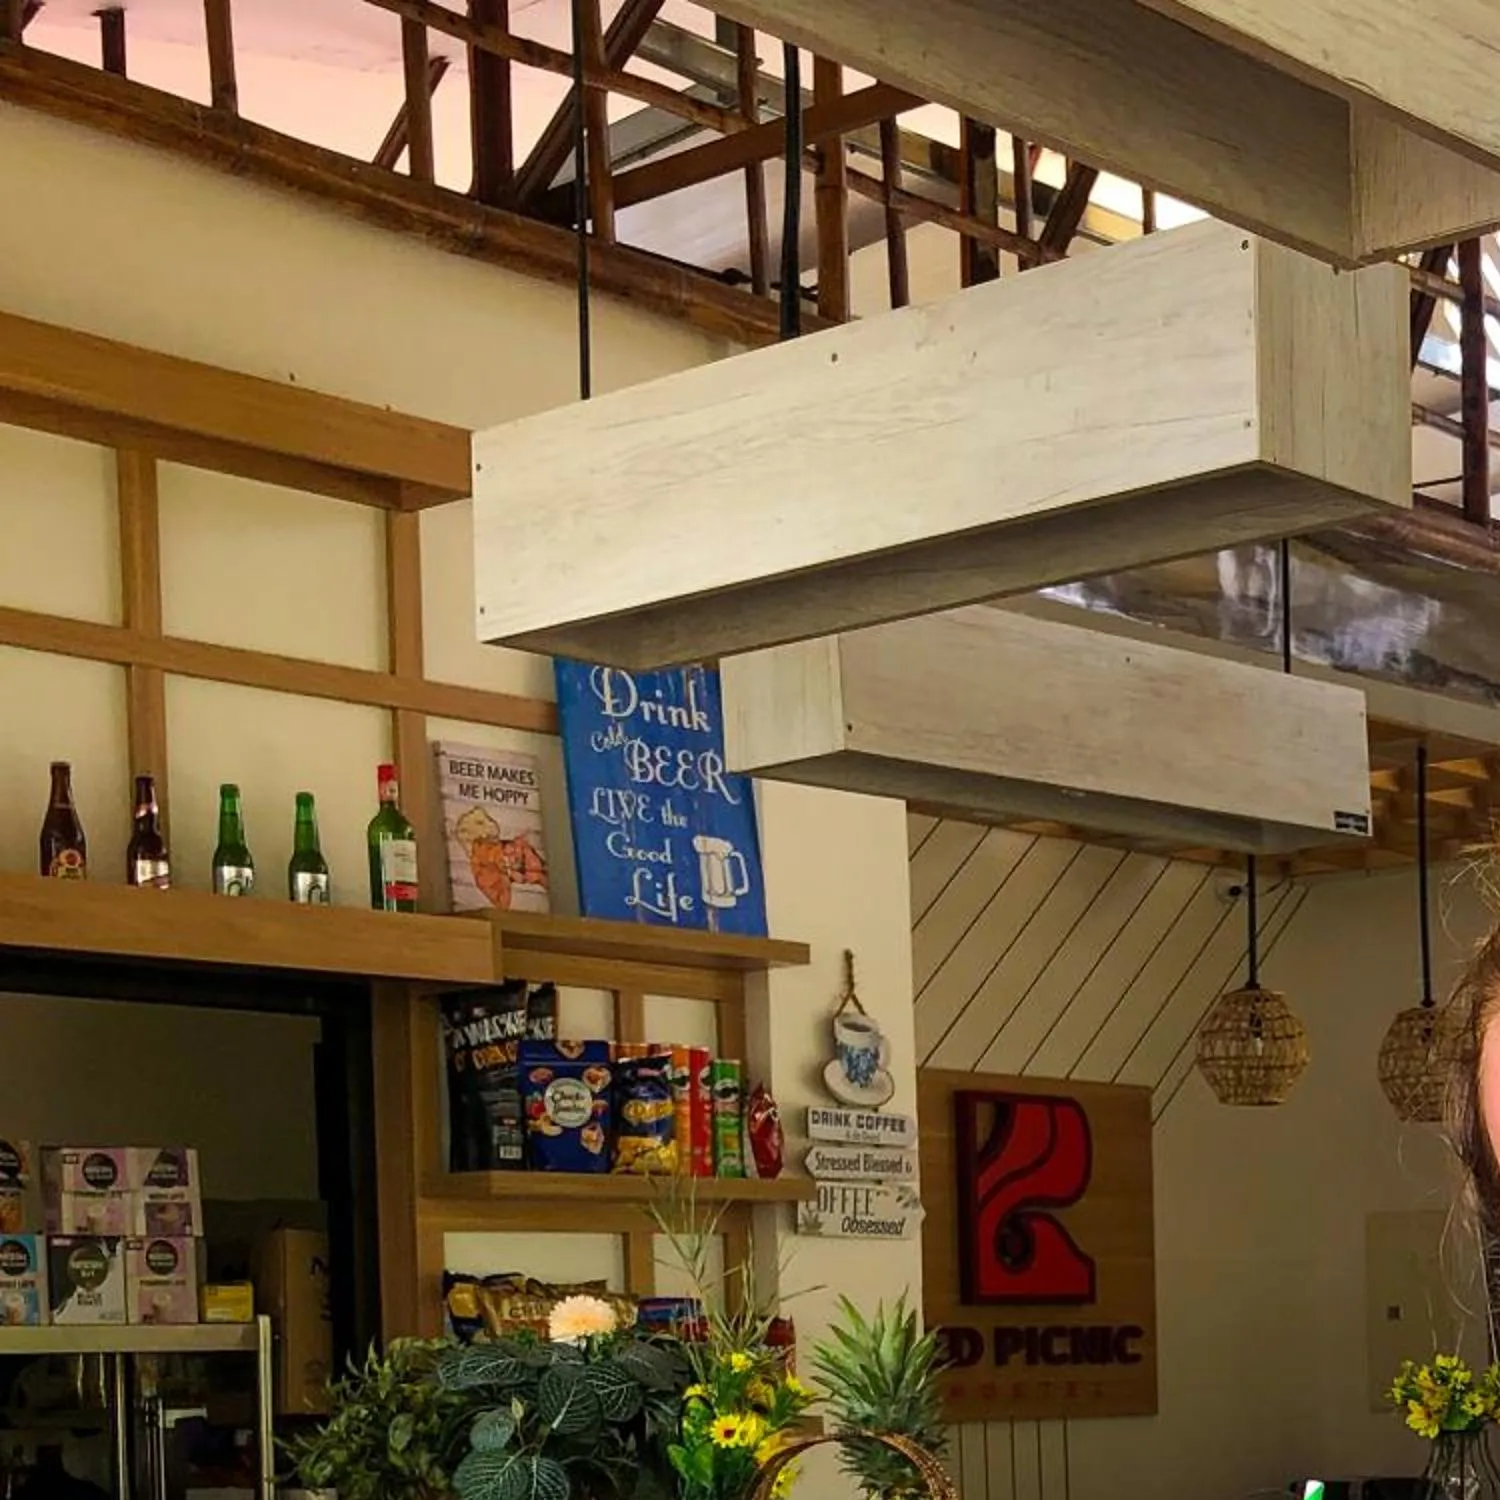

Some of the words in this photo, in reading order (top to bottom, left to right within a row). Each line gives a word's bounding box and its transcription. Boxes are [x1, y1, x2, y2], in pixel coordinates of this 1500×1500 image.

[590, 665, 711, 733] Drink
[449, 759, 485, 778] BEER
[487, 764, 535, 785] MAKES
[624, 738, 741, 805] BEER
[459, 783, 480, 799] ME
[483, 785, 529, 806] HOPPY
[588, 787, 654, 824] LIVE
[661, 800, 687, 829] the
[607, 831, 672, 863] Good
[625, 869, 694, 923] Life
[811, 1110, 851, 1128] DRINK
[855, 1114, 906, 1133] COFFEE
[815, 1151, 860, 1171] Stressed
[863, 1153, 902, 1174] Blessed
[995, 1325, 1144, 1367] PICNIC
